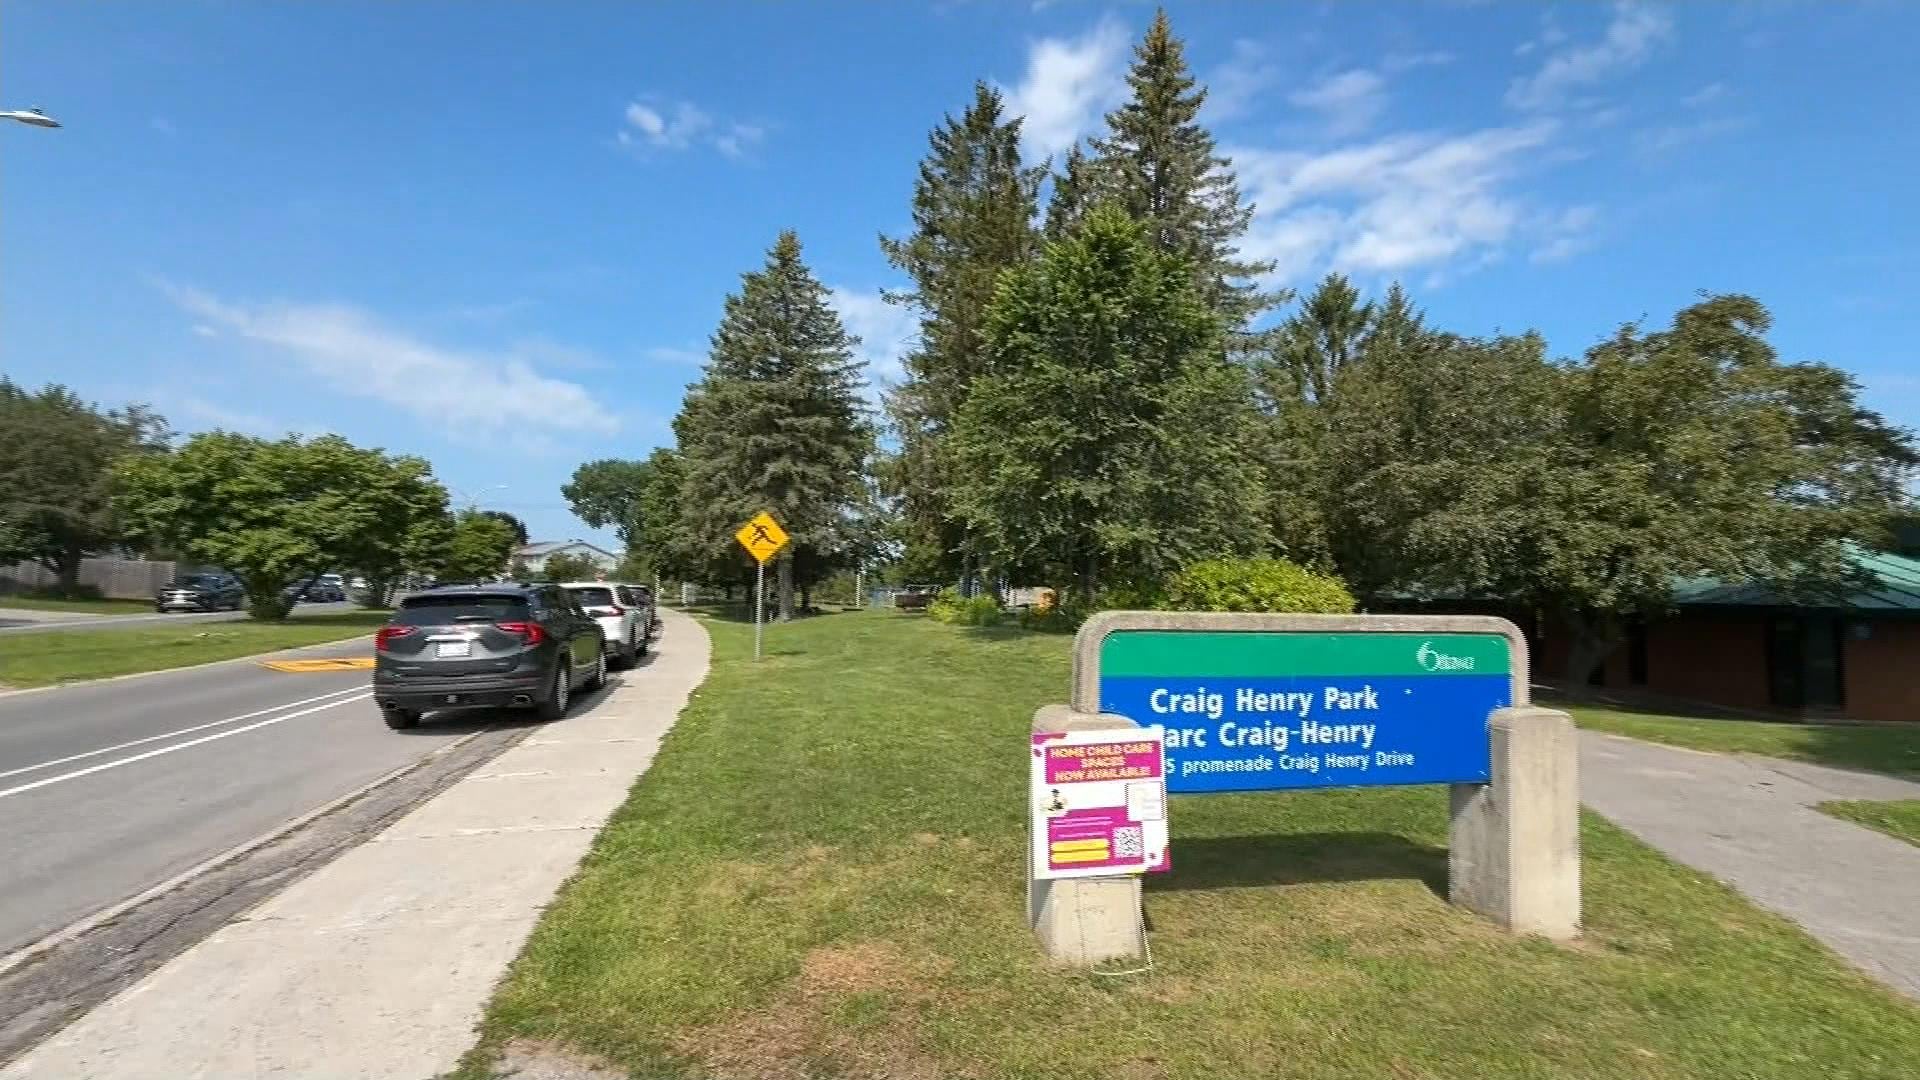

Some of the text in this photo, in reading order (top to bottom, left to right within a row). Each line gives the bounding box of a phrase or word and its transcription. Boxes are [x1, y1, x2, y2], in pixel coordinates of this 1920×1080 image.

[1150, 685, 1379, 720] Craig Henry Park
[1157, 720, 1376, 752] arc Craig-Henry
[1051, 742, 1153, 759] HOME CHILD CARE
[1080, 755, 1126, 769] SPACES
[1182, 755, 1273, 777] promenade
[1279, 752, 1320, 774] Craig
[1325, 752, 1370, 771] Henry
[1376, 750, 1415, 767] Drive
[1055, 770, 1086, 782] NOW
